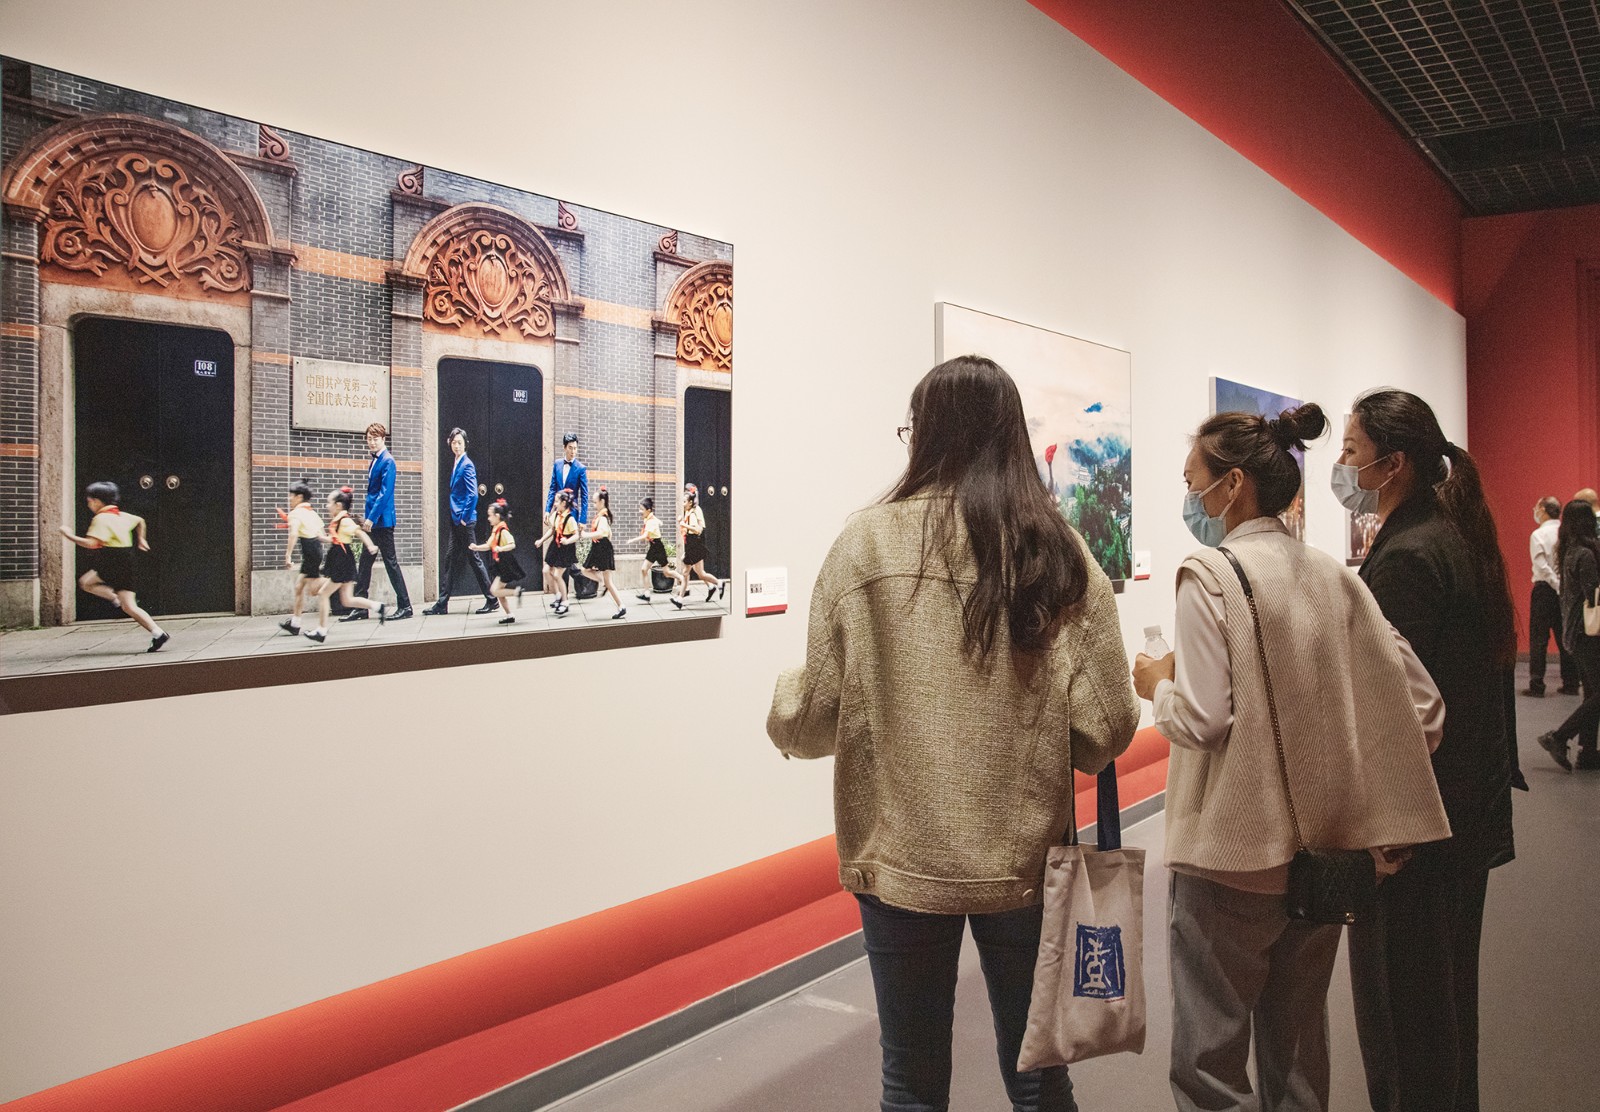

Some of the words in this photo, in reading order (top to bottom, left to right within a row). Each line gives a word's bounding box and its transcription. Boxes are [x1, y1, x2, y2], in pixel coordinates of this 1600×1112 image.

[197, 362, 213, 371] 108
[306, 374, 378, 393] 中国共产党第一次
[306, 390, 377, 410] 全国代表大会会址
